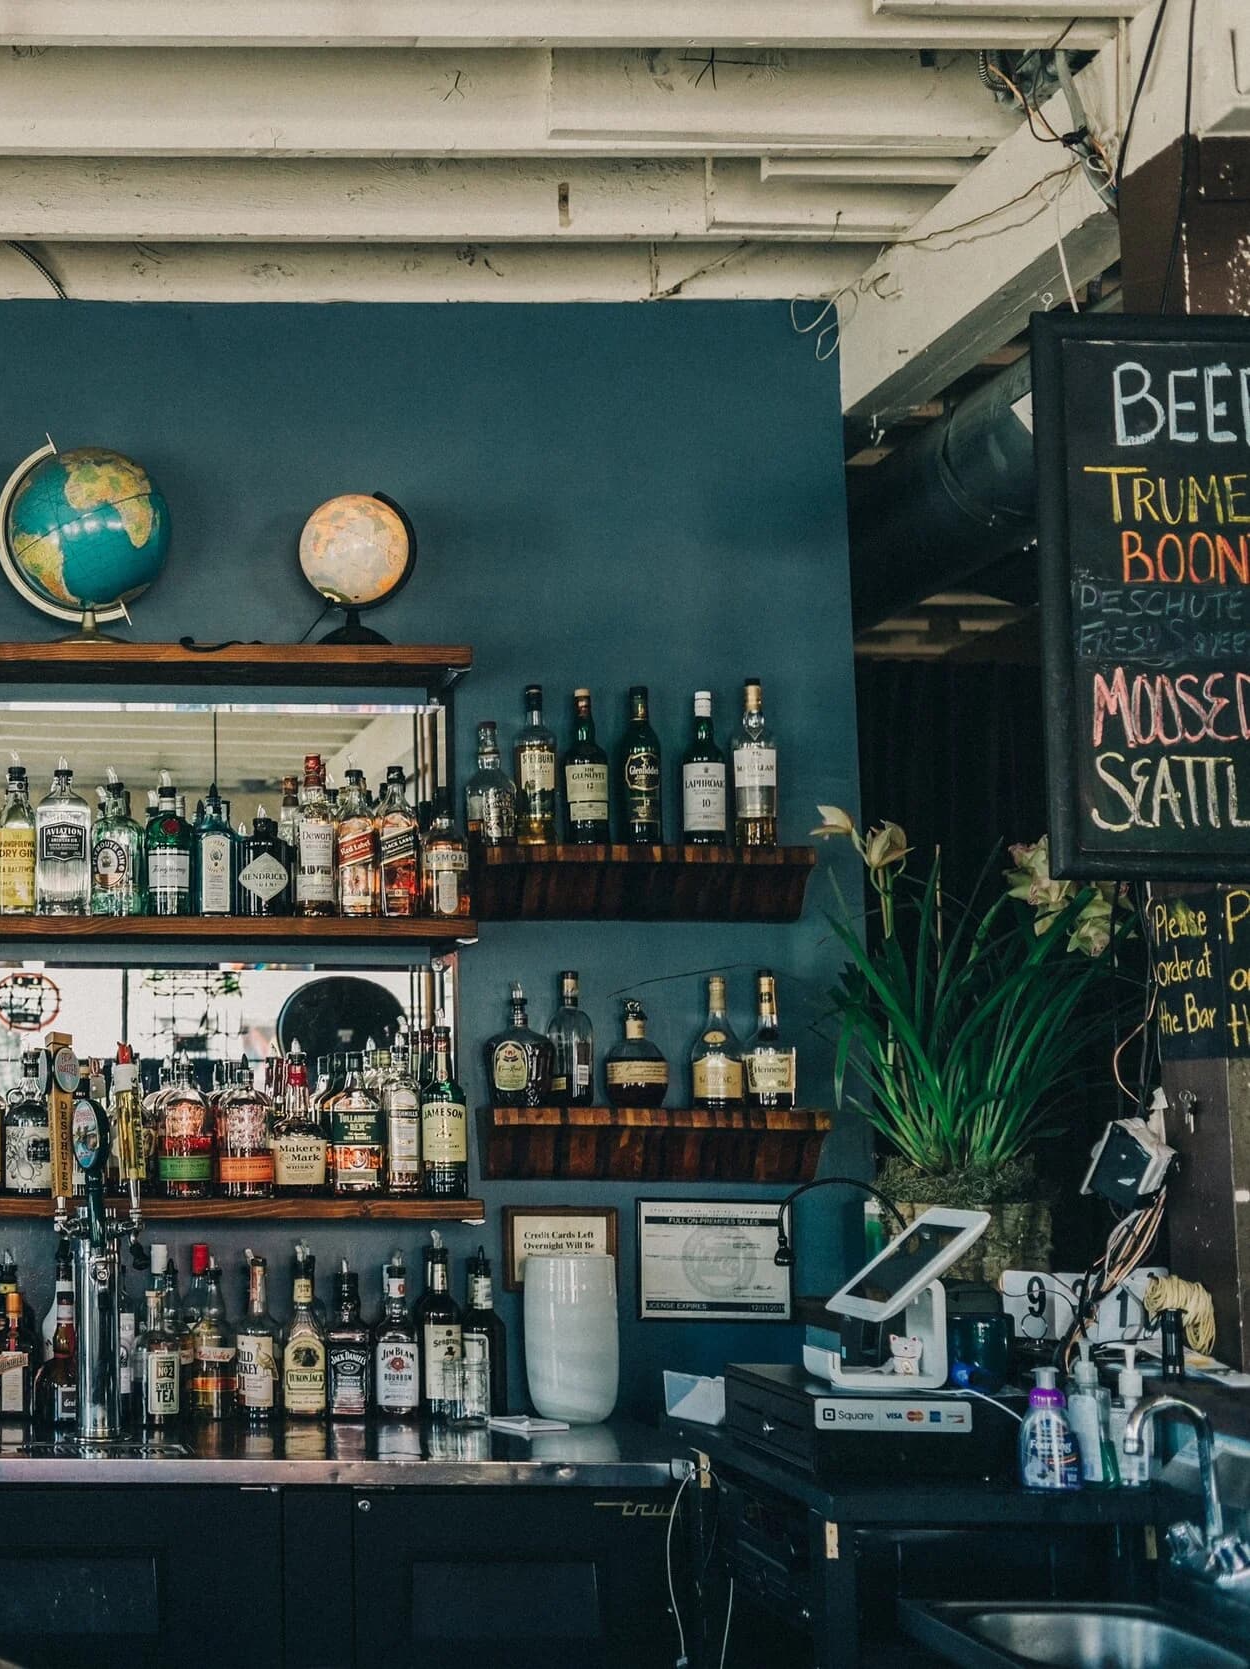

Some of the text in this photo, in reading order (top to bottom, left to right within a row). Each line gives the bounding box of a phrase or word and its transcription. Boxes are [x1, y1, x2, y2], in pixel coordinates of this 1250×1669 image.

[1113, 361, 1250, 446] BEE
[1121, 530, 1250, 584] BOON
[572, 772, 605, 781] GLENLIVET
[702, 798, 710, 808] 10
[46, 827, 83, 836] AVIATION
[0, 849, 17, 858] DRY
[1154, 903, 1208, 947] Please
[1157, 942, 1212, 987] order at
[1184, 992, 1217, 1034] Bar
[421, 1107, 463, 1120] JAMESON
[59, 1100, 69, 1192] DESCHUTES
[279, 1144, 322, 1153] Maker's
[291, 1153, 321, 1162] Mark
[668, 1217, 686, 1225] FULL
[524, 1231, 594, 1240] Credit Cards Left
[523, 1241, 595, 1251] Overnight Will Be
[331, 1351, 367, 1365] JACK DANIEL'S
[381, 1348, 415, 1362] JIM BEAM
[309, 1373, 324, 1382] JACK
[384, 1373, 413, 1382] BOURBON
[156, 1389, 175, 1403] TEA
[838, 1410, 874, 1421] Square
[886, 1412, 903, 1420] VISA
